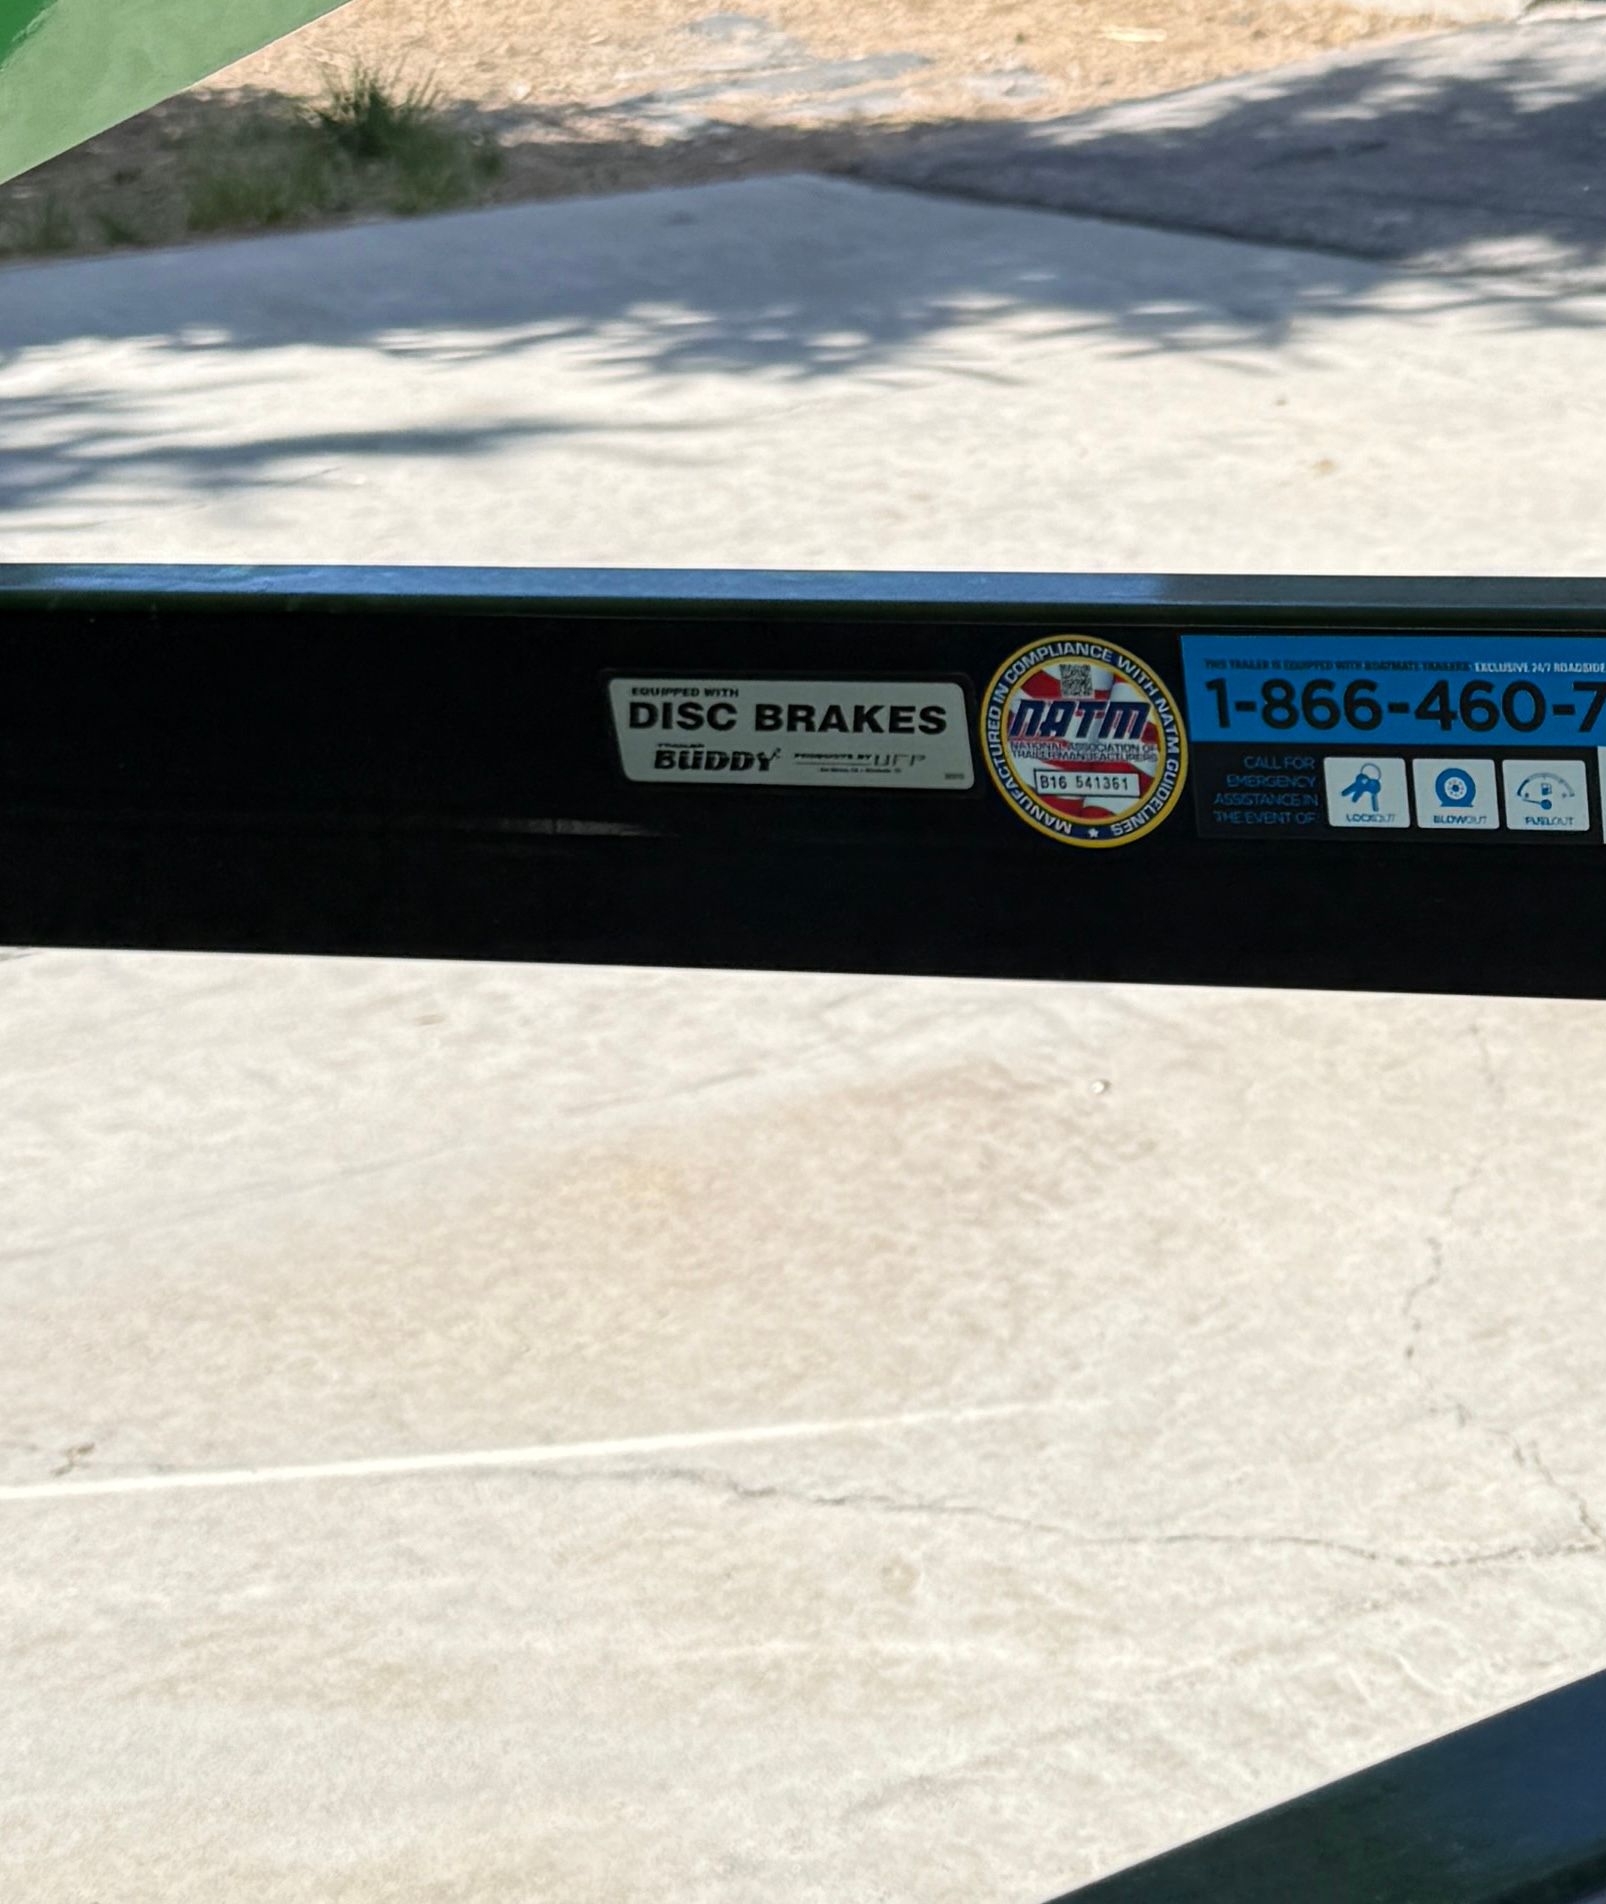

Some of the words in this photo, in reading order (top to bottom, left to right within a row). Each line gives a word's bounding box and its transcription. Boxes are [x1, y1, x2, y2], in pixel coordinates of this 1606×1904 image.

[1006, 641, 1113, 685] COMPLIANCE
[1474, 662, 1530, 672] EXCLUSIVE
[1532, 662, 1551, 673] 24/7
[1553, 662, 1606, 673] ROADSIDE
[1116, 655, 1160, 696] WITH
[631, 687, 700, 697] EQUIPPED
[703, 687, 739, 697] WITH
[993, 686, 1010, 705] IN
[628, 701, 738, 732] DISC
[755, 703, 948, 735] BRAKES
[1154, 698, 1181, 755] NATM
[1069, 742, 1140, 753] ASSOCIATION
[654, 749, 780, 772] BUDDY
[1243, 755, 1281, 769] CALL
[1283, 755, 1317, 770] FOR
[986, 708, 1073, 835] MANUFACTURED
[1040, 776, 1068, 791] B16
[1075, 777, 1129, 792] 541361
[1226, 774, 1317, 788] EMERGENCY
[1110, 760, 1180, 837] GUIDELINES
[1213, 792, 1303, 806] ASSISTANCE
[1304, 793, 1319, 807] IN
[1212, 810, 1242, 823] THE
[1243, 810, 1292, 824] EVENT
[1345, 812, 1396, 823] LOCKOUT
[1433, 814, 1487, 825] BLOWOUT
[1524, 815, 1574, 826] FUELOUT
